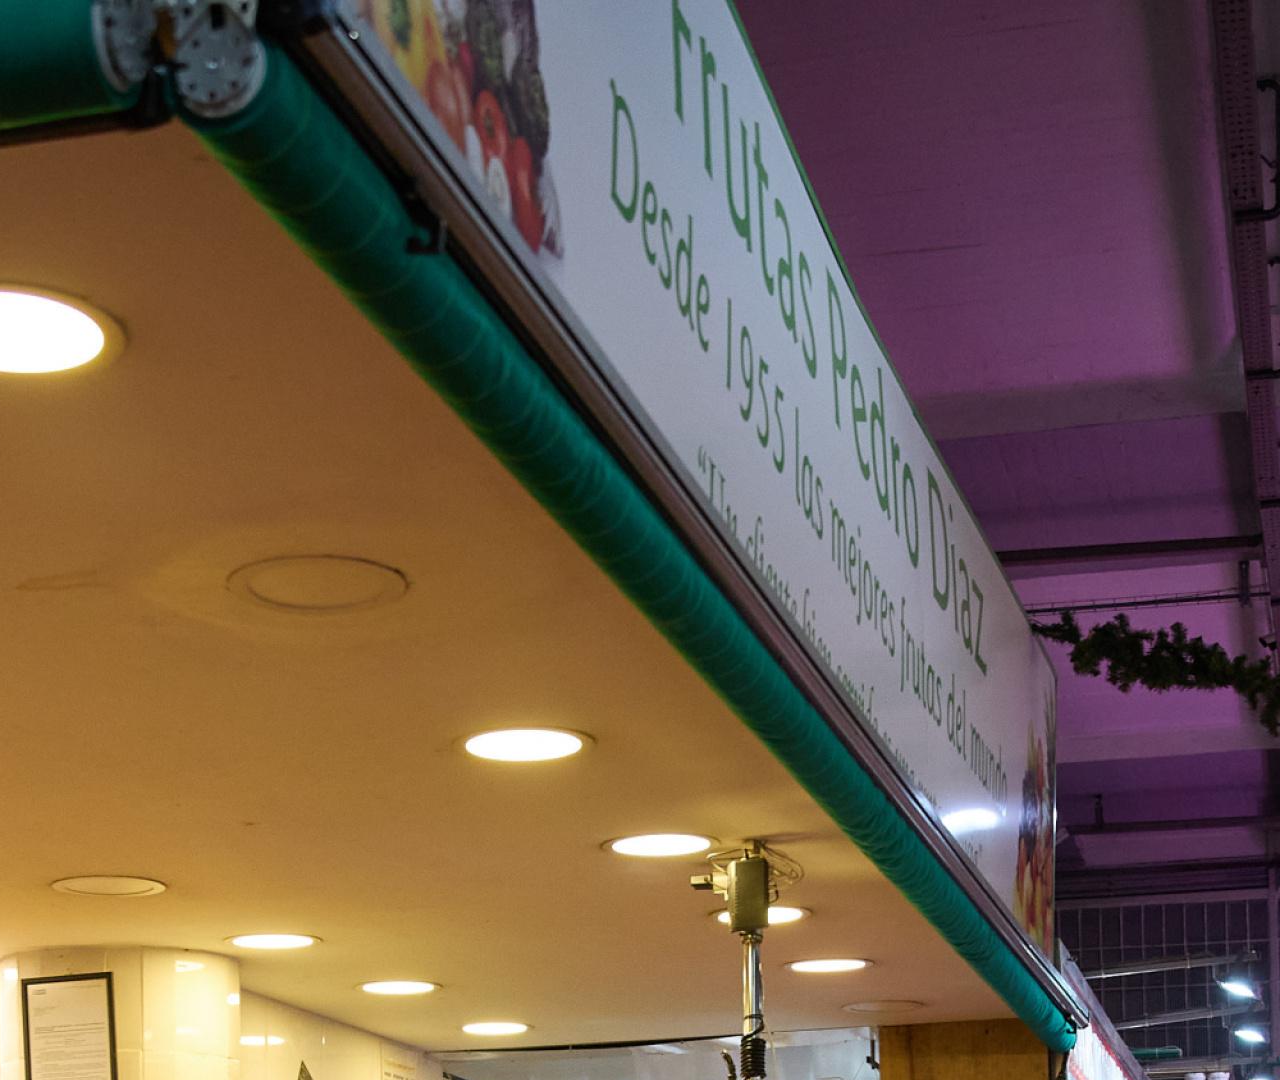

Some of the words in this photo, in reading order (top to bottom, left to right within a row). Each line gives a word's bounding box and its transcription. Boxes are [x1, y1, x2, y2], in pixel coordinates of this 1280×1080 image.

[610, 78, 710, 353] Desde
[725, 297, 785, 474] 1955
[795, 406, 824, 540] las
[830, 499, 896, 658] mejores
[900, 596, 943, 727] frutas
[946, 673, 967, 761] del
[826, 266, 920, 568] Pedro
